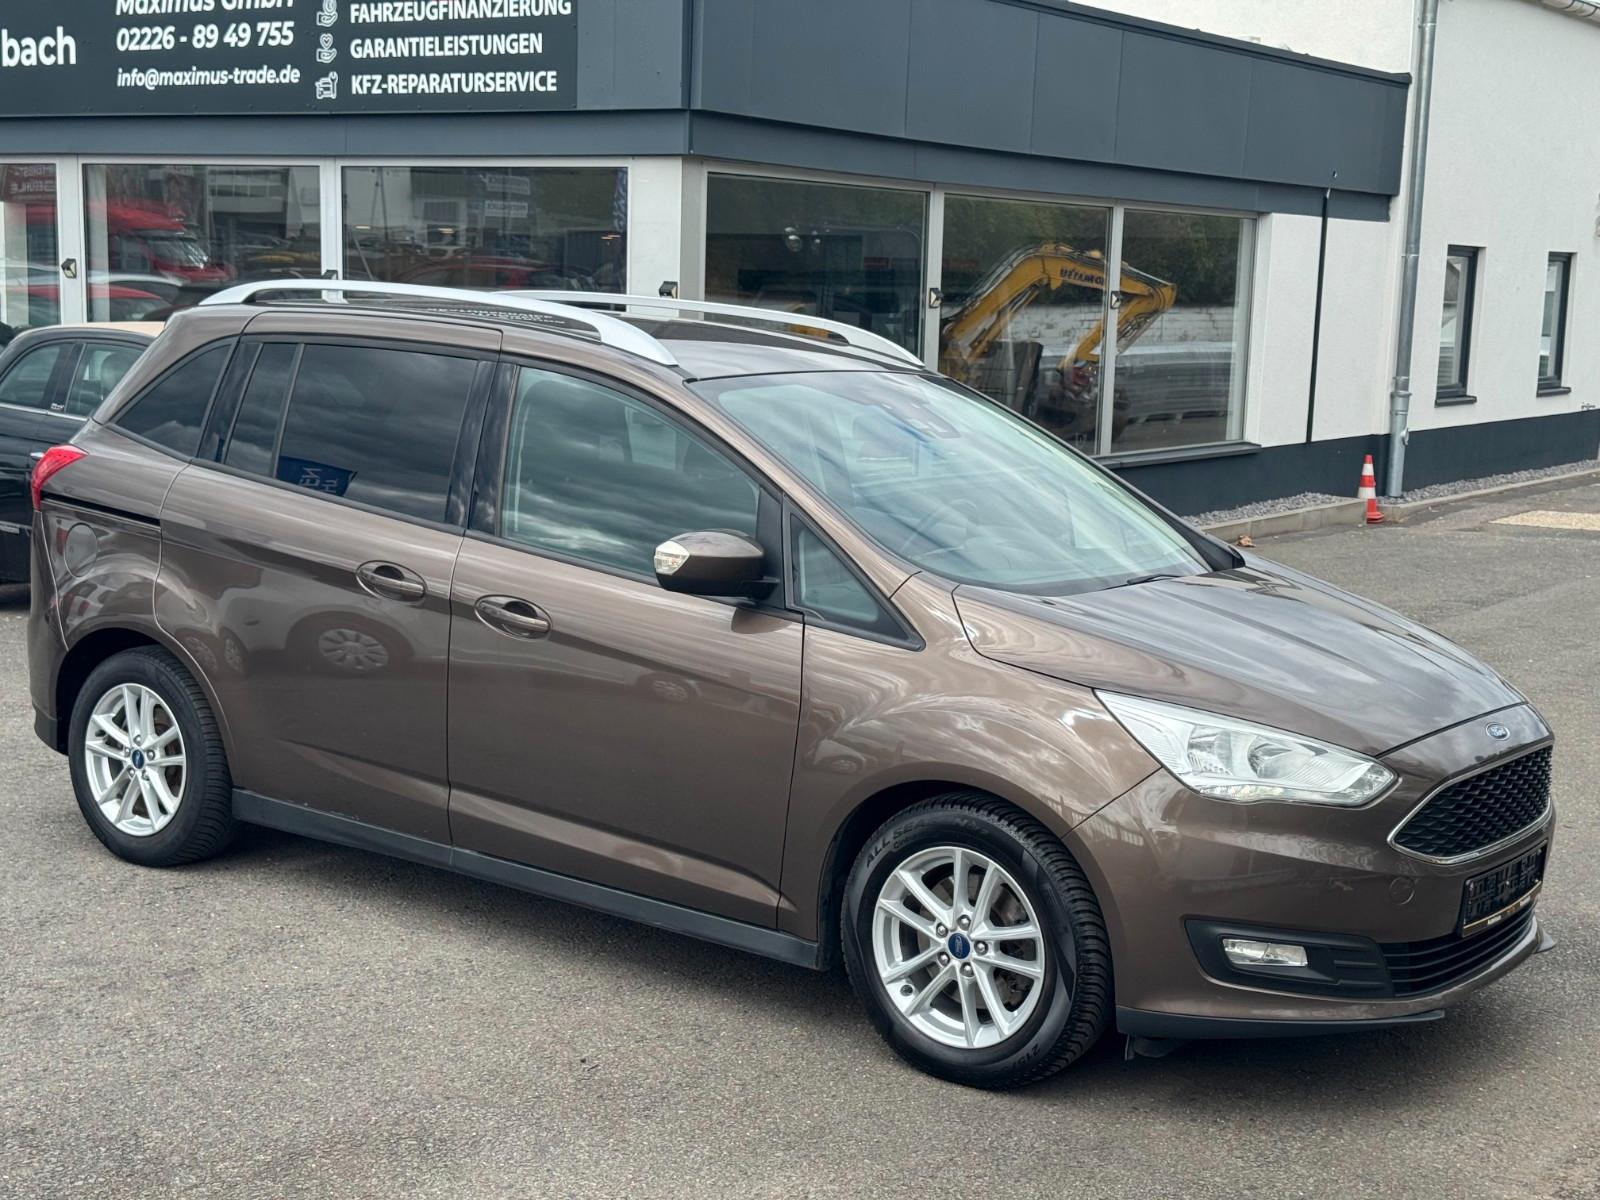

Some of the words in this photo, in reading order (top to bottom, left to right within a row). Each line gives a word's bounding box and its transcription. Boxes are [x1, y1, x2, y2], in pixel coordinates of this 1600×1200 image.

[350, 0, 572, 23] FAHRZEUGFINANZIERUNG
[1, 26, 77, 67] bach
[116, 26, 175, 51] 02226
[192, 24, 218, 48] 89
[223, 23, 251, 48] 49
[256, 21, 294, 47] 755
[350, 33, 543, 59] GARANTIELEISTUNGEN
[116, 64, 300, 90] info@maximus-trade.de
[351, 71, 557, 94] KFZ-REPARATURSERVICE
